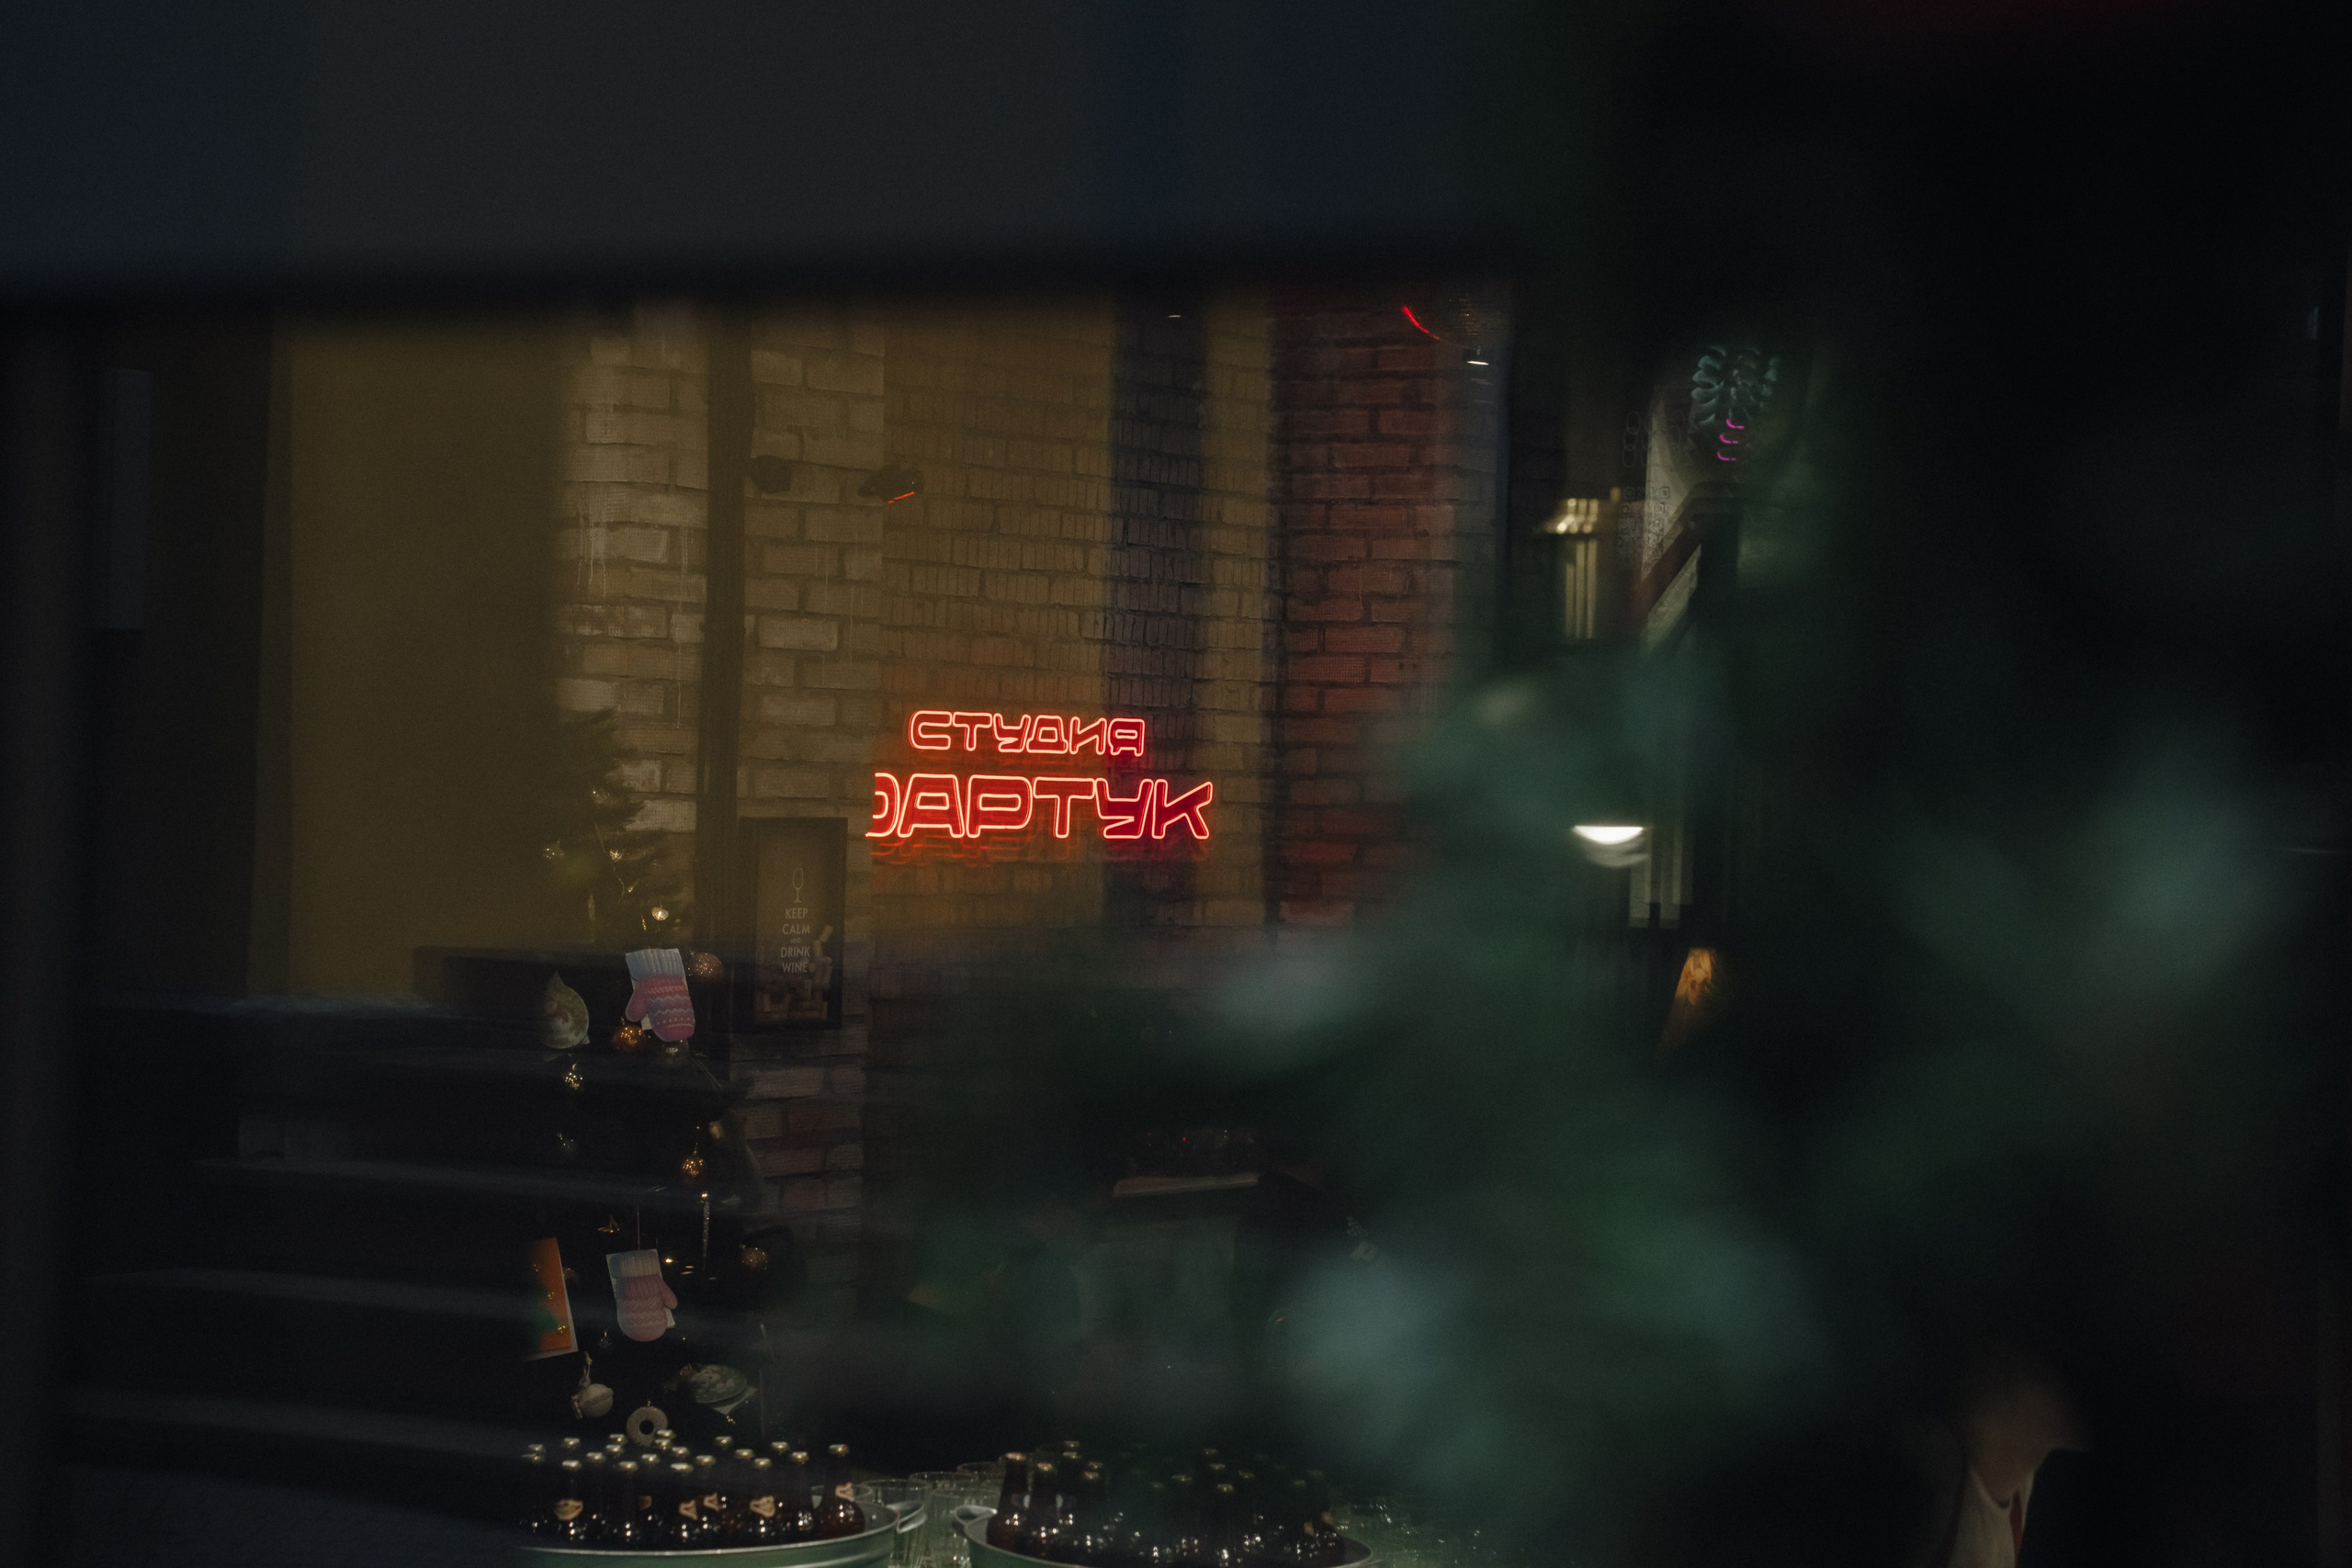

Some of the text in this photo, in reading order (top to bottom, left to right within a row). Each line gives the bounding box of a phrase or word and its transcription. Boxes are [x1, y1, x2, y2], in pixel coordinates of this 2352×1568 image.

[909, 710, 1146, 757] СТУДИЯ
[786, 908, 808, 919] KEEP
[782, 923, 810, 935] CALM
[780, 946, 810, 958] DRINK
[782, 961, 808, 973] WINE
